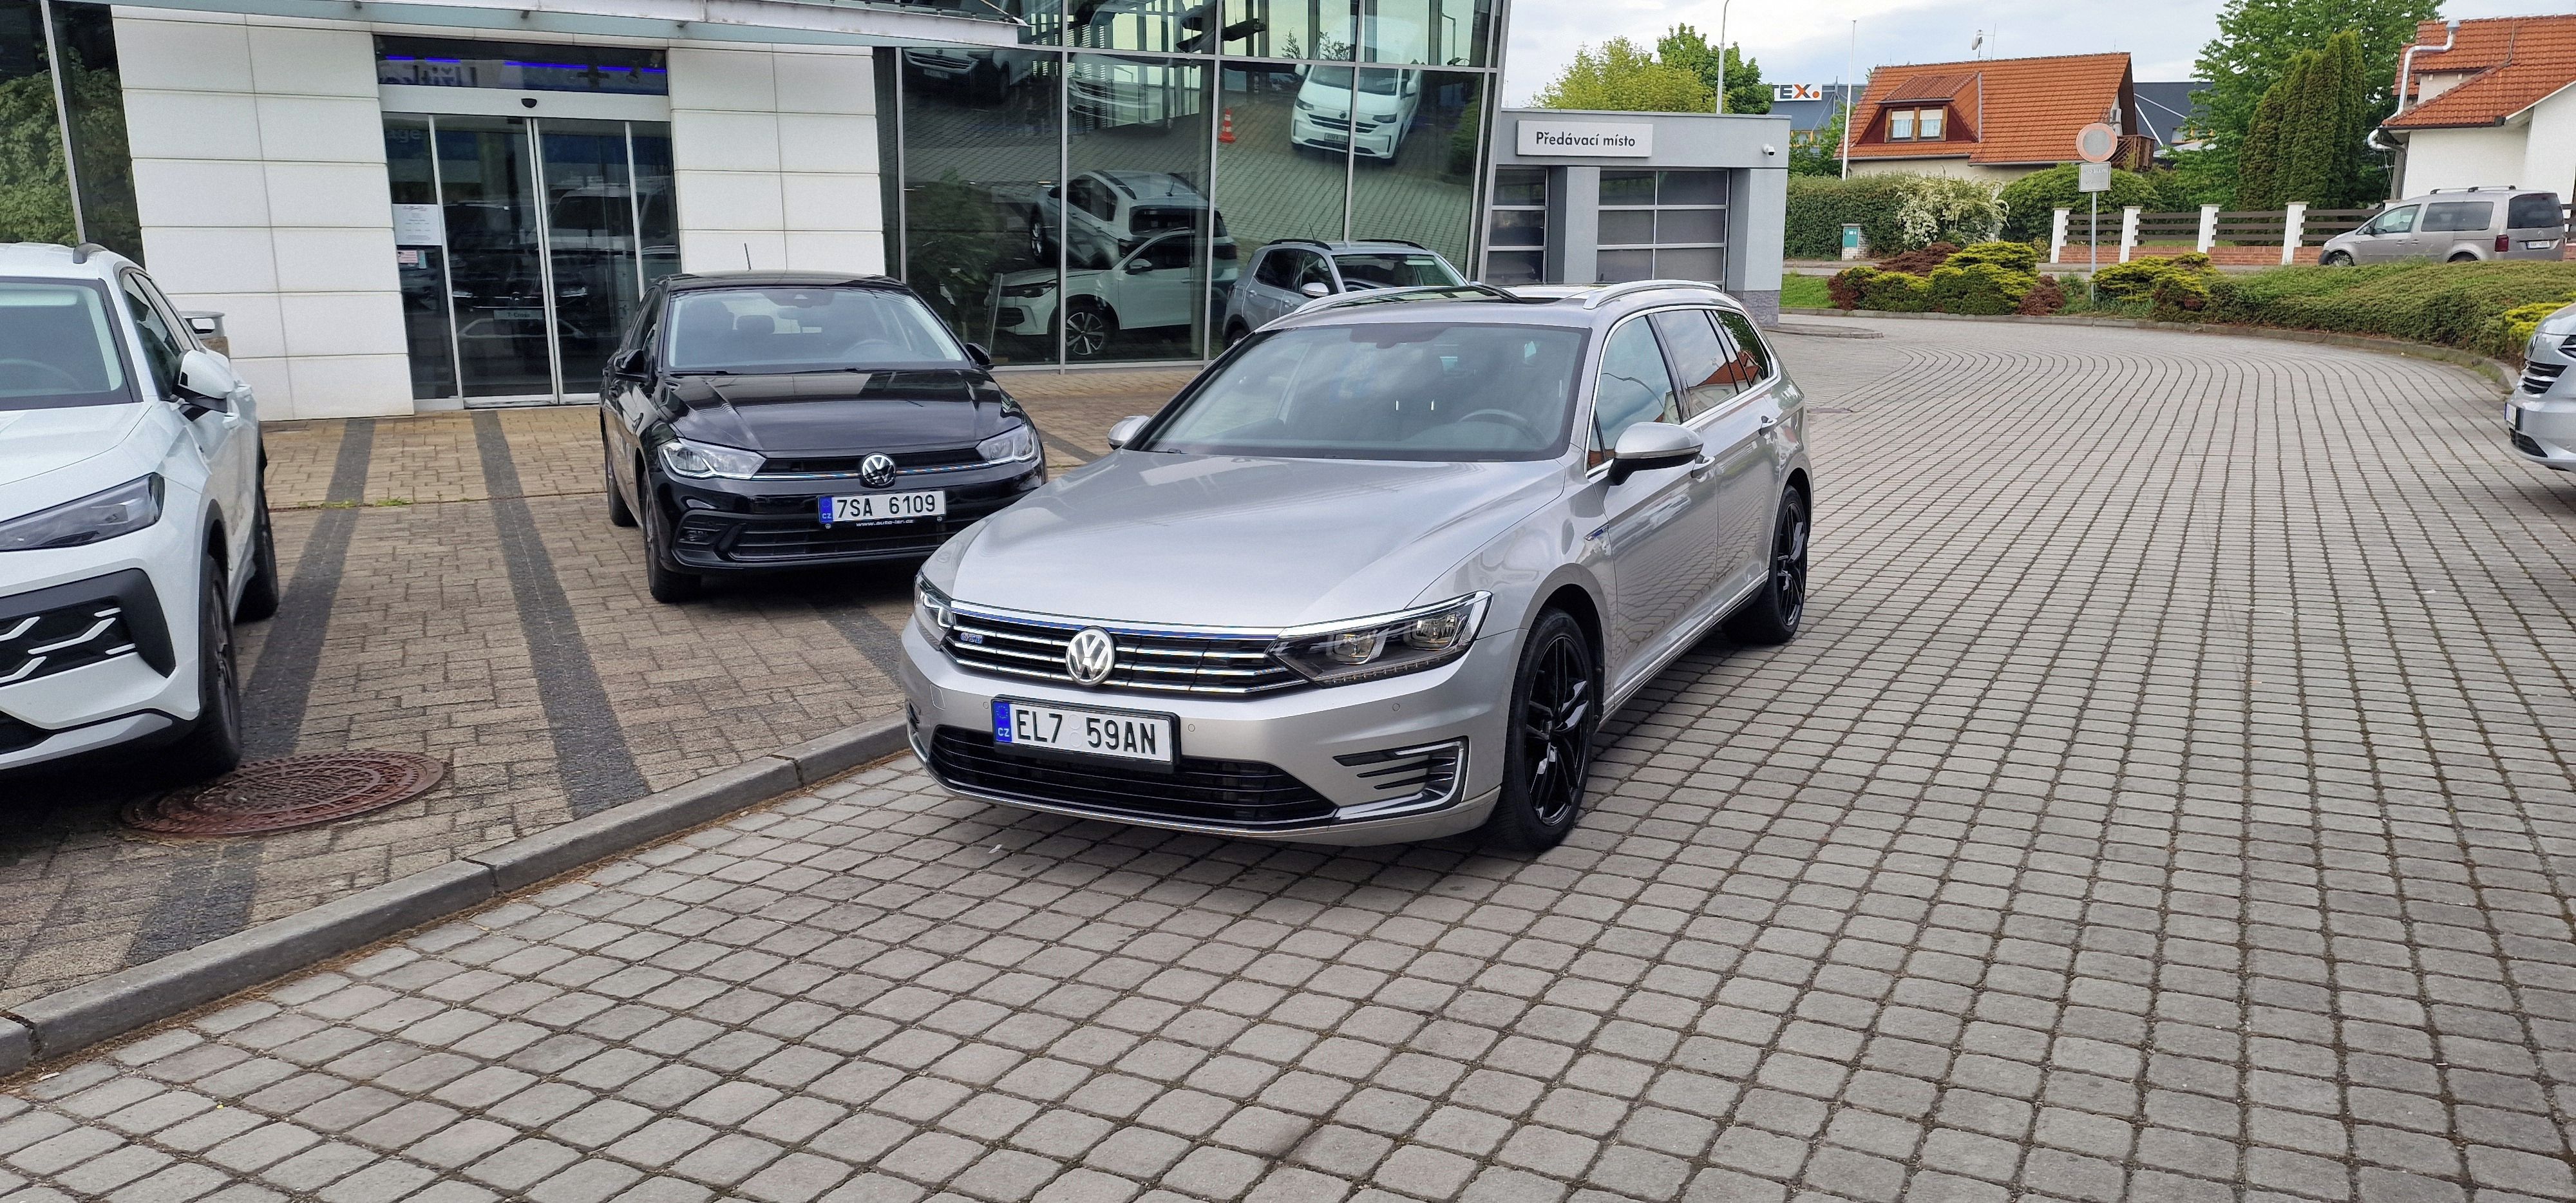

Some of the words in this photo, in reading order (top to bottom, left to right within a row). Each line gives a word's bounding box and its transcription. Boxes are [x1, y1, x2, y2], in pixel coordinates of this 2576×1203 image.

[1536, 131, 1600, 146] Předávací
[1603, 133, 1636, 147] místo
[837, 497, 873, 518] 7SA
[889, 495, 934, 514] 6109
[960, 632, 983, 644] GTE
[998, 727, 1010, 737] CZ
[1016, 709, 1063, 744] EL7
[1086, 717, 1157, 755] 59AN
